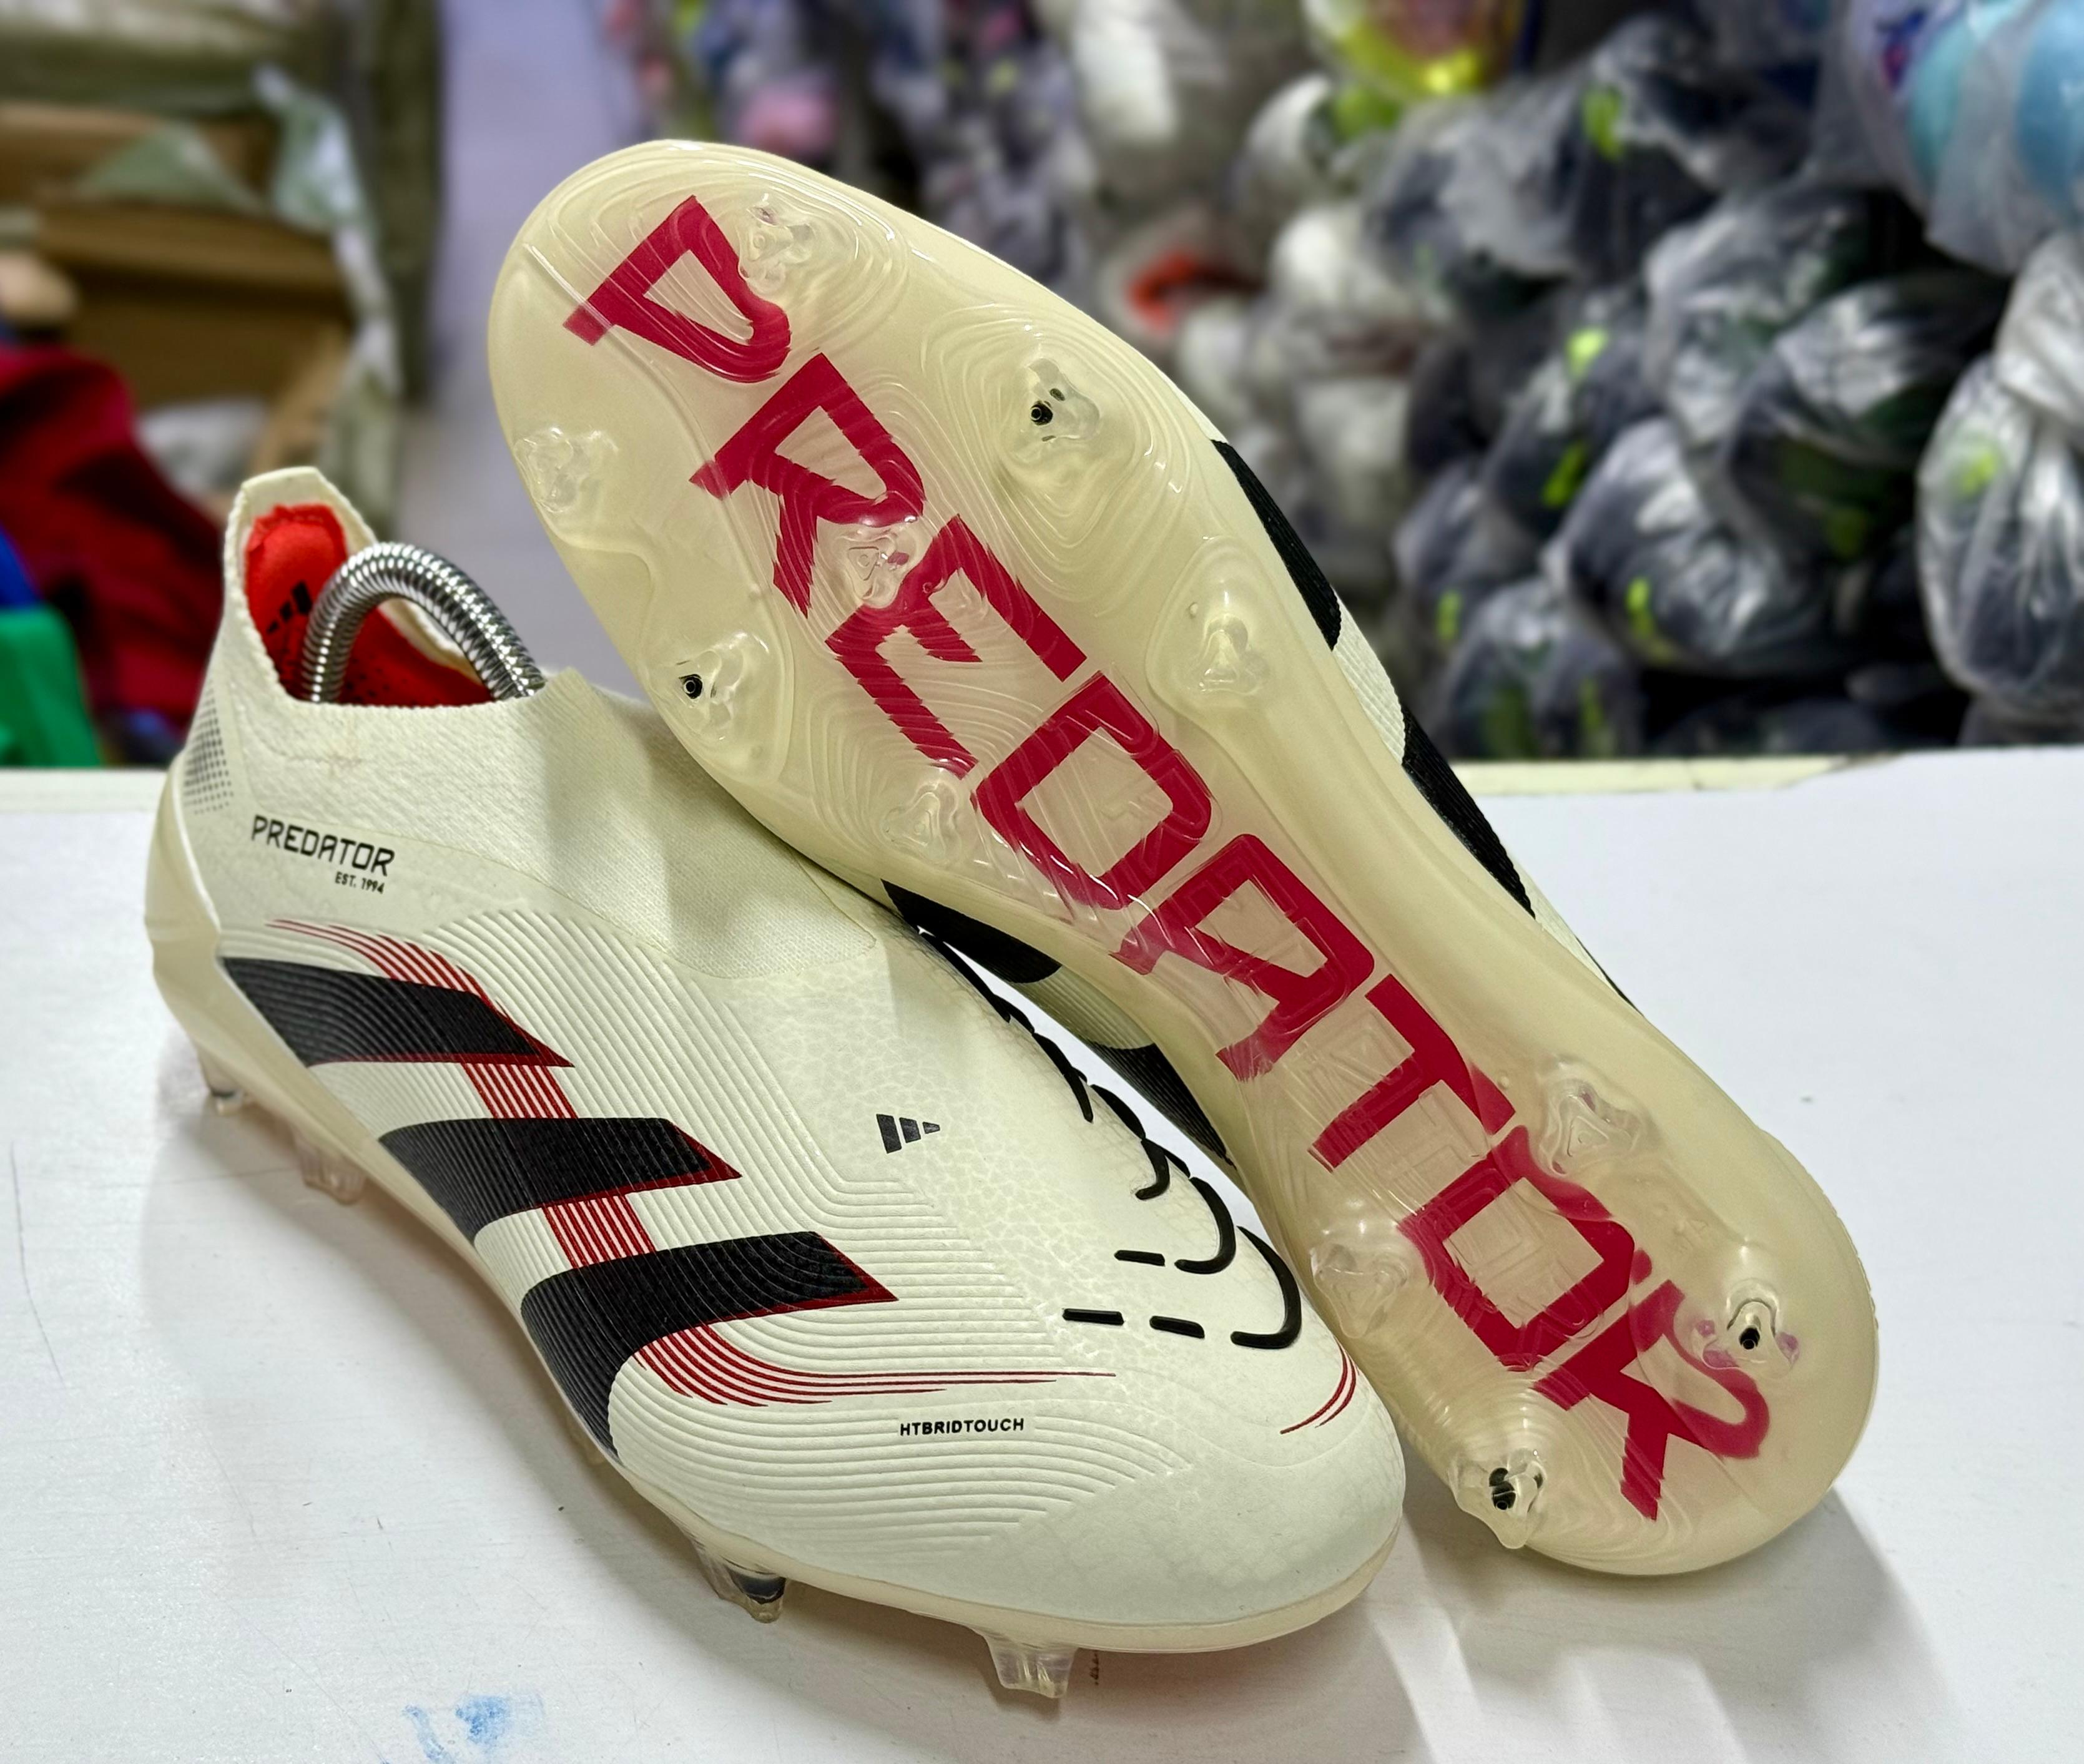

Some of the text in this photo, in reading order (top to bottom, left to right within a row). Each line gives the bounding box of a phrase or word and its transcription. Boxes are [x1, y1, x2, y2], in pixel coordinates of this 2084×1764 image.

[251, 815, 395, 876] PREDATOR
[563, 195, 1771, 1521] PREDATOR
[335, 871, 385, 894] EST. 1994
